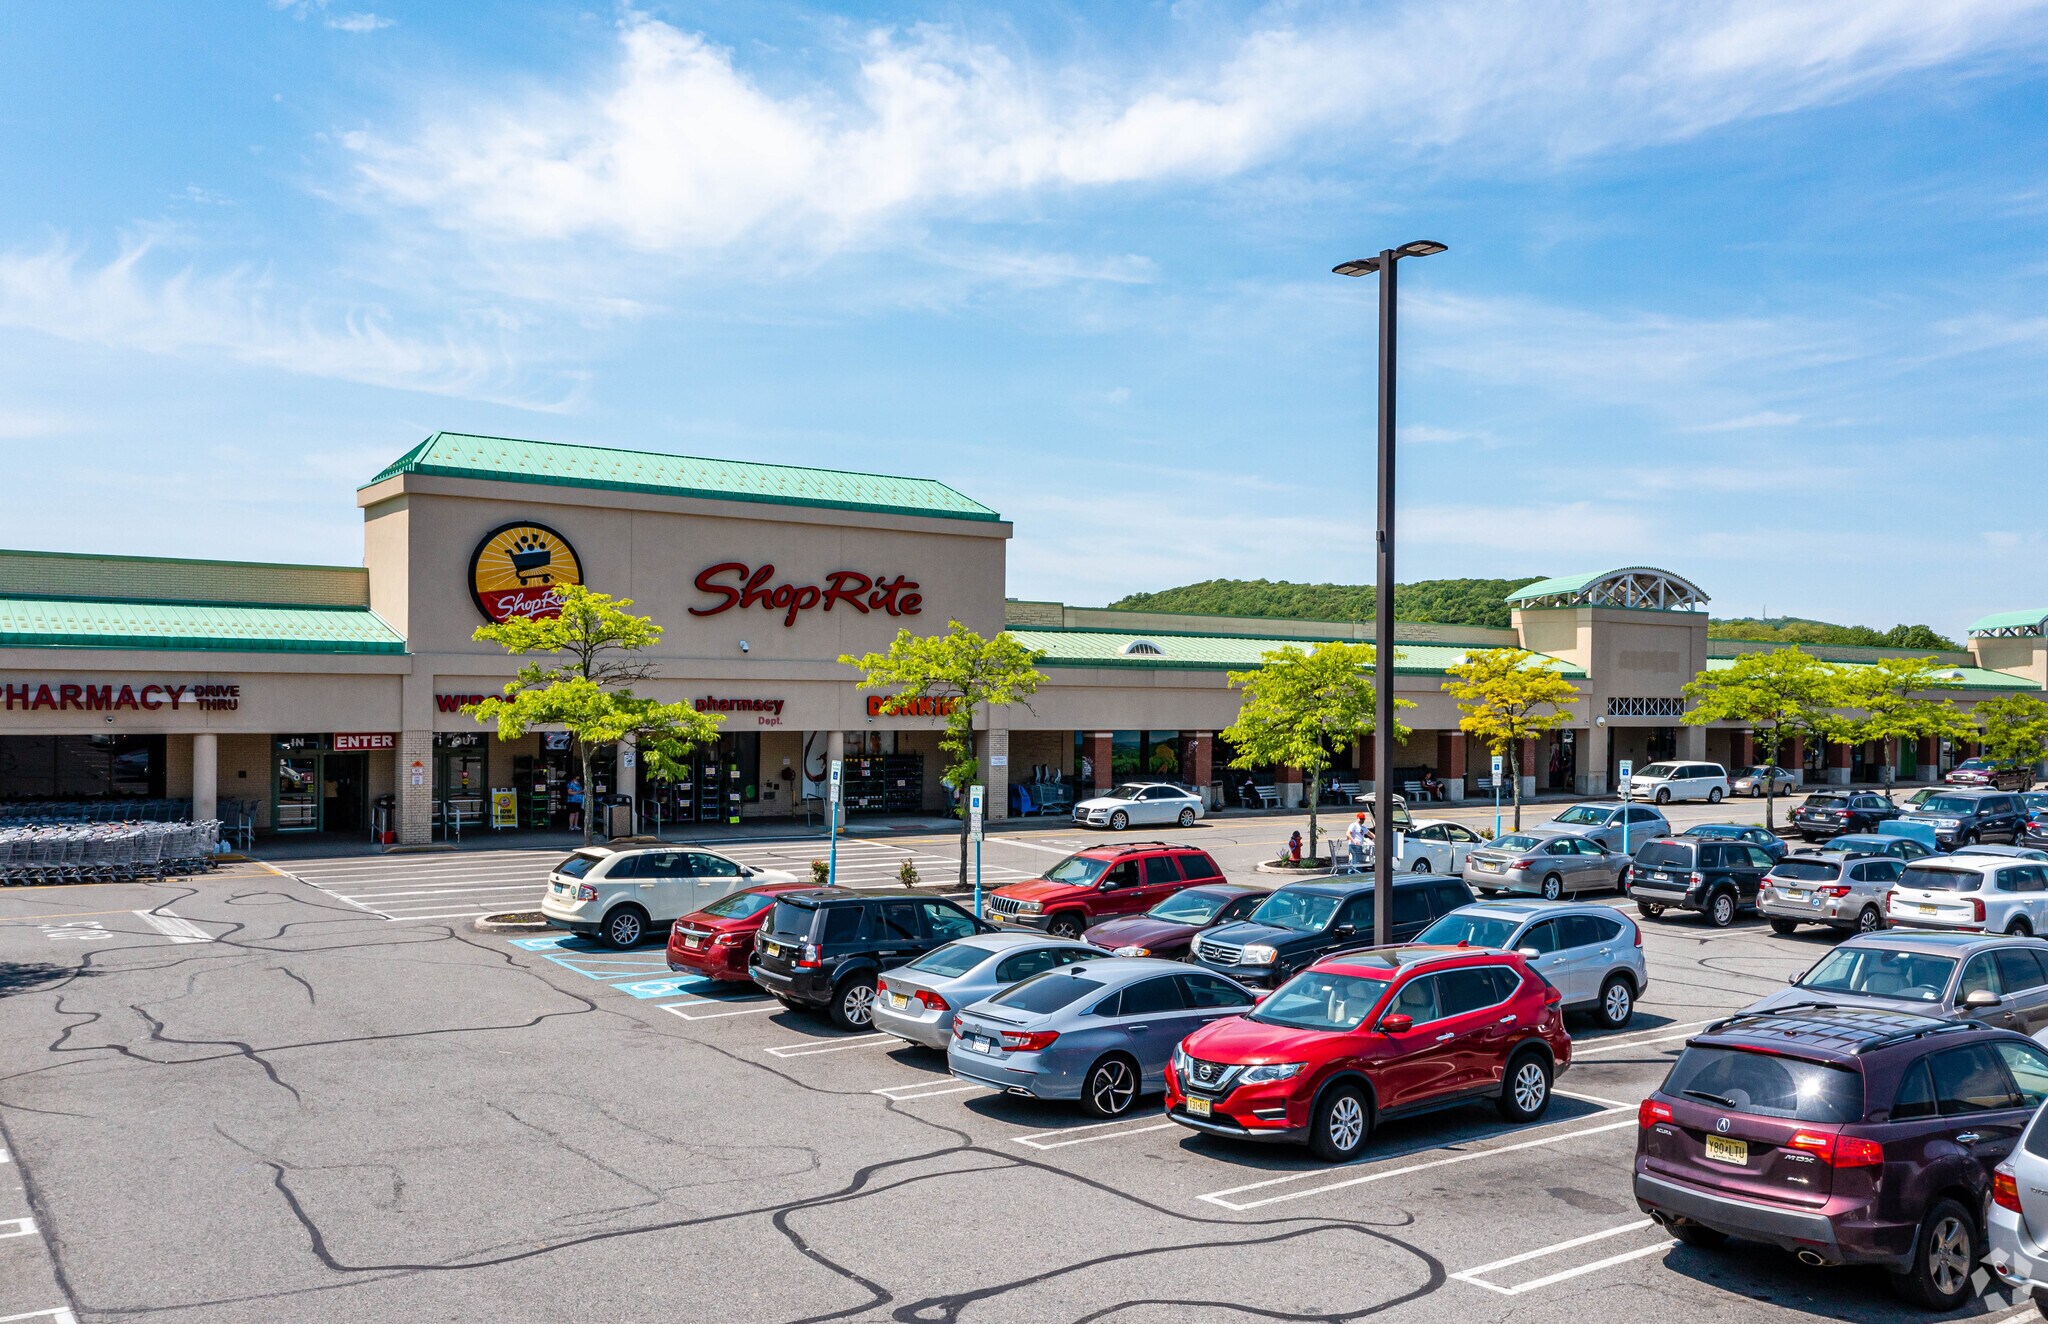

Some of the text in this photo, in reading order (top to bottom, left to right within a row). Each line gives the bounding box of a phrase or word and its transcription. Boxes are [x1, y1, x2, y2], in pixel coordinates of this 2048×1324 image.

[687, 562, 923, 627] ShopRite
[194, 685, 240, 697] DRIVE
[0, 684, 187, 711] HARMACY
[197, 698, 238, 711] THRU
[695, 696, 785, 715] pharmacy
[758, 717, 783, 727] Dept.
[291, 738, 305, 747] IN
[336, 735, 393, 748] ENTER
[453, 736, 478, 747] OUT
[1785, 1154, 1815, 1164] MDX
